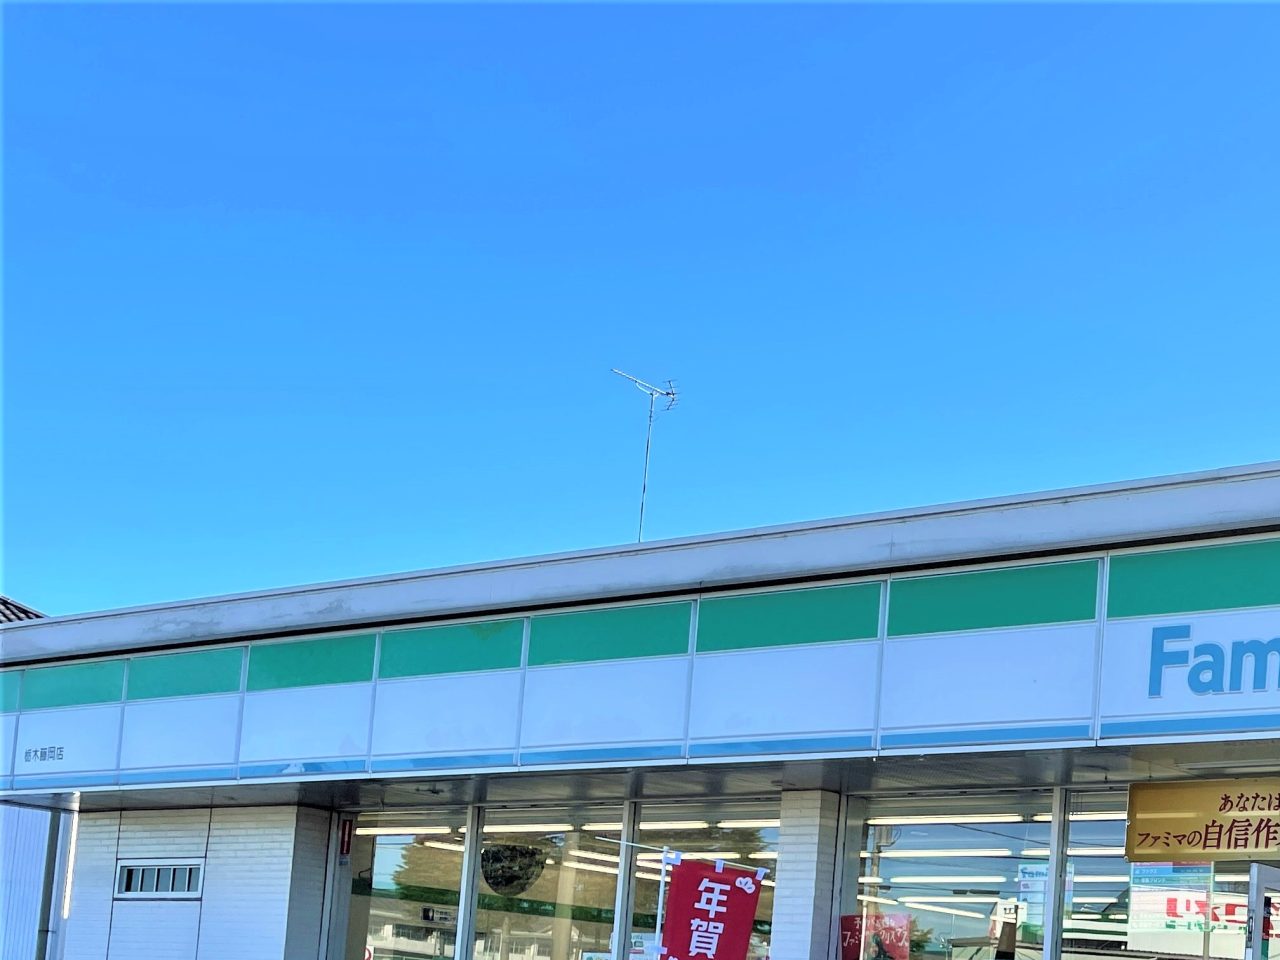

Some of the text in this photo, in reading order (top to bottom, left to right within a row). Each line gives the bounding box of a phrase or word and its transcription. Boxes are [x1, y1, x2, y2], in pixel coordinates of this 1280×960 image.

[25, 747, 64, 762] 栃木藤岡店
